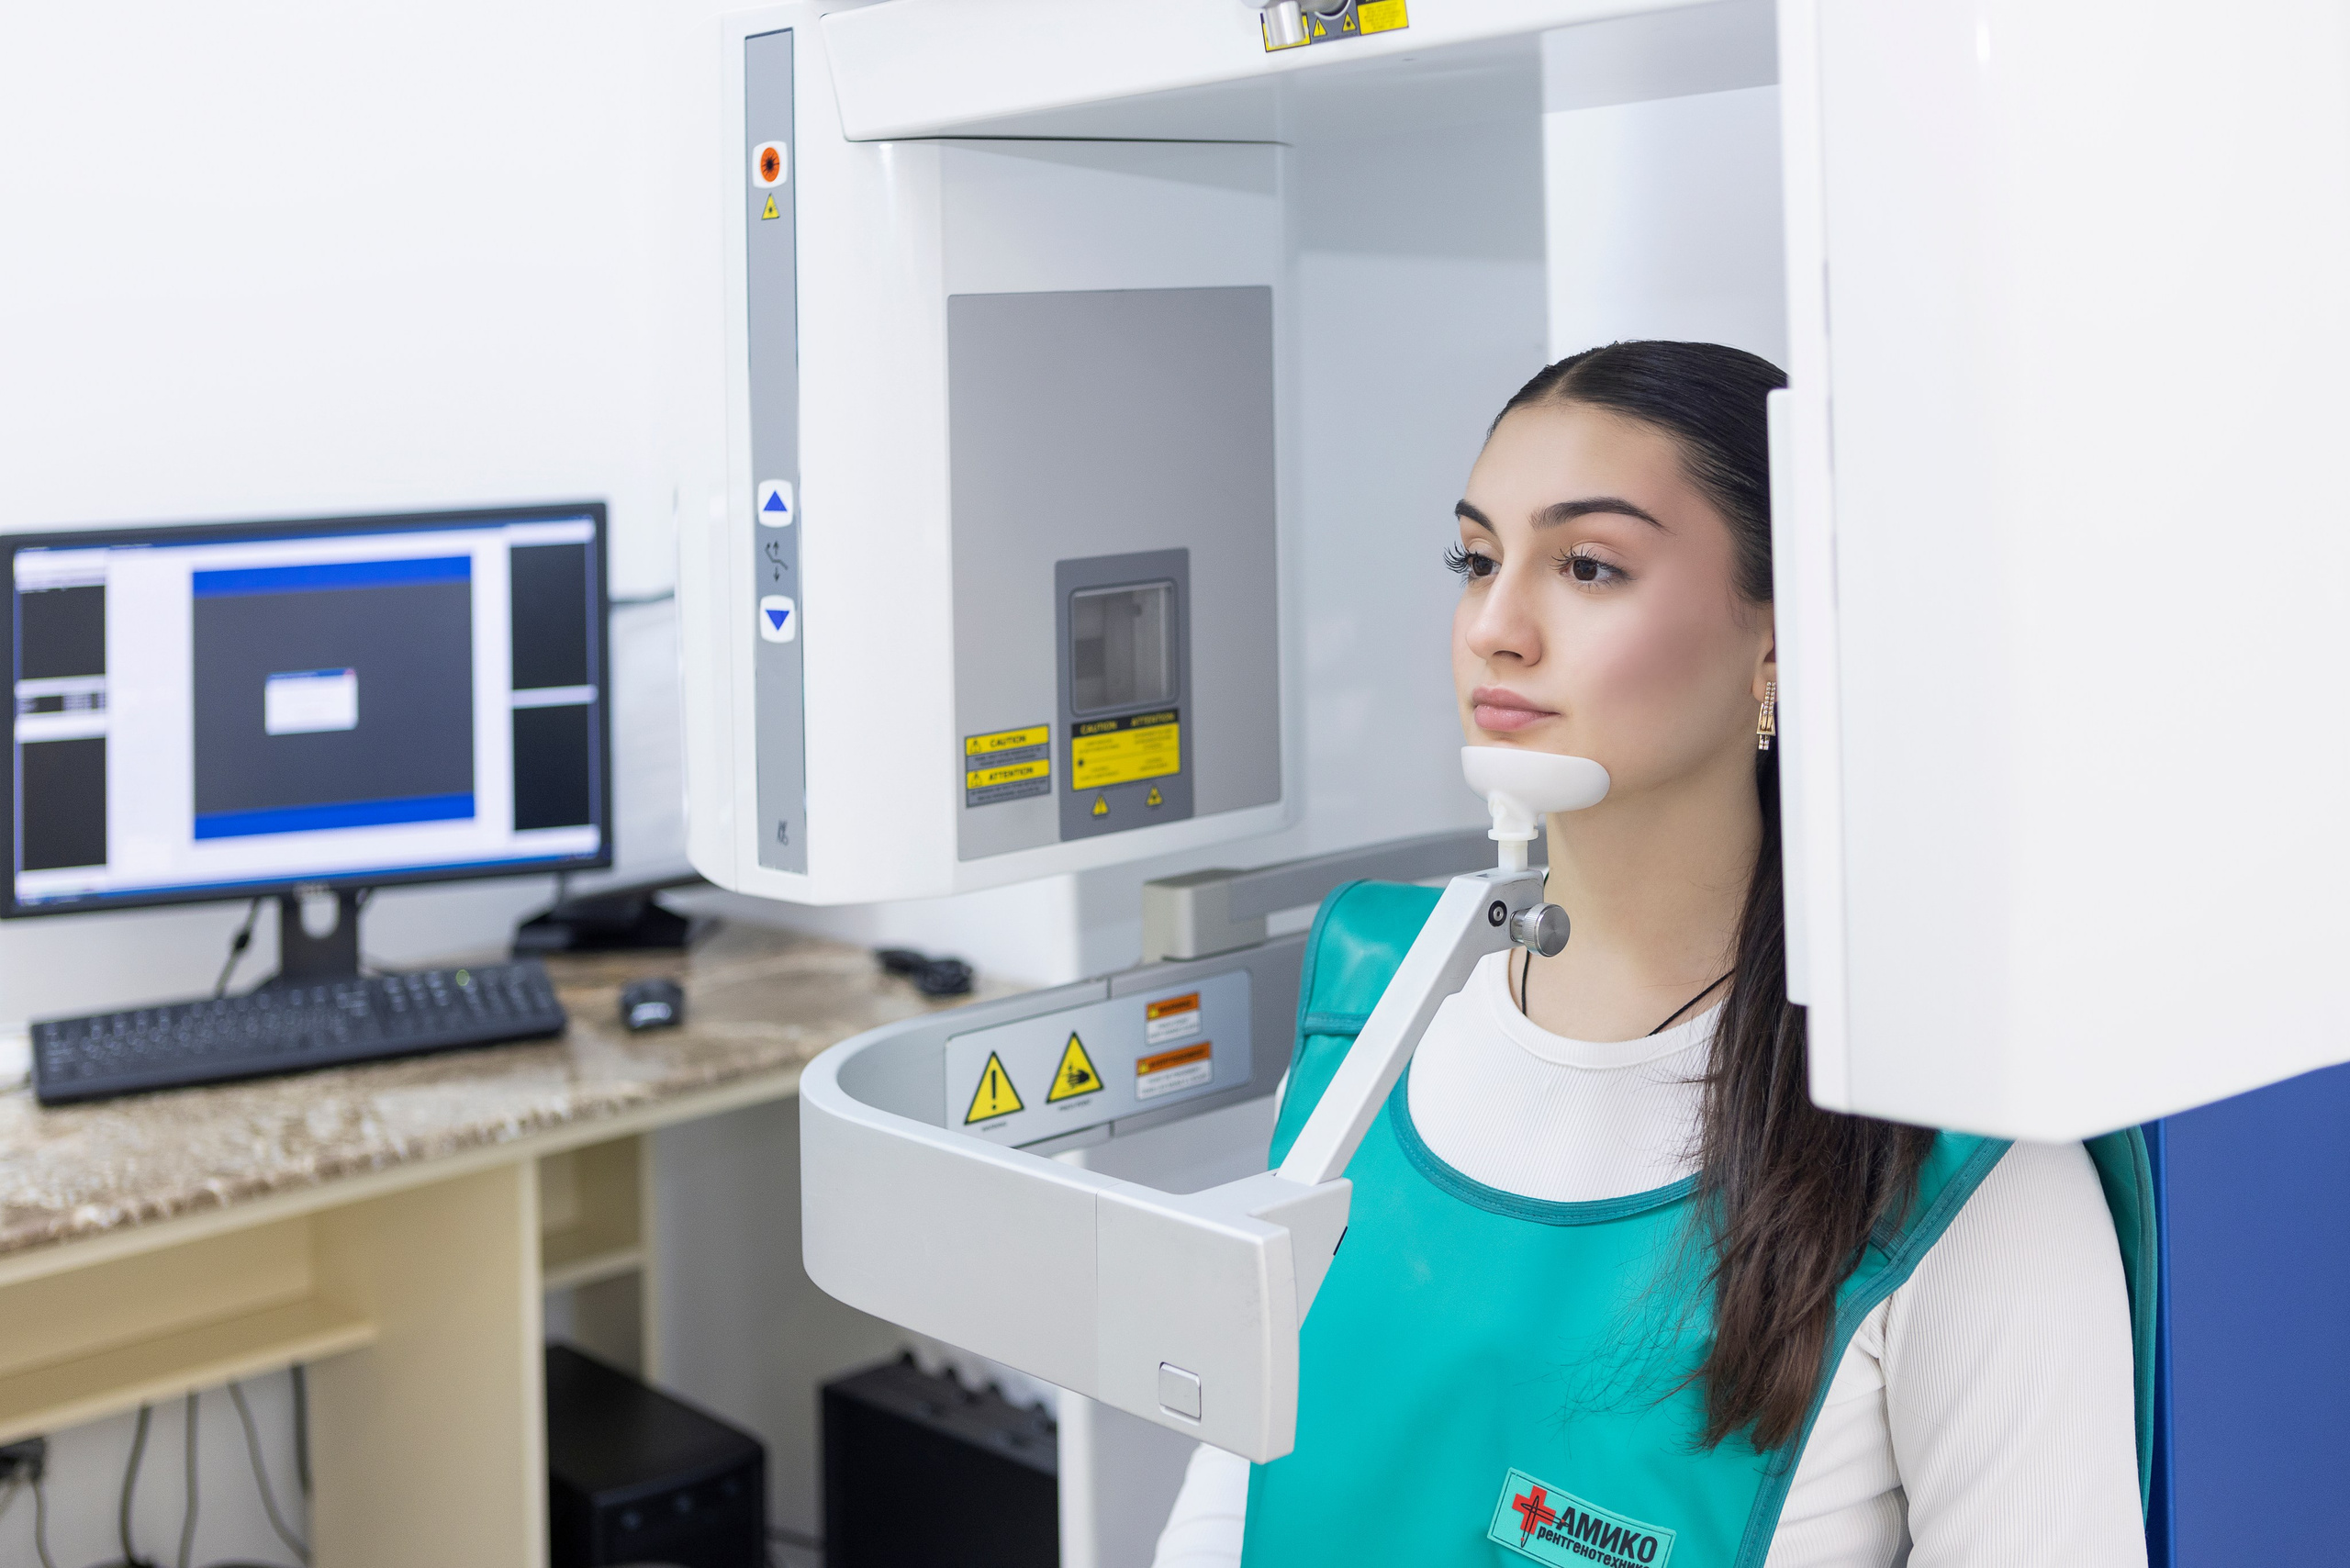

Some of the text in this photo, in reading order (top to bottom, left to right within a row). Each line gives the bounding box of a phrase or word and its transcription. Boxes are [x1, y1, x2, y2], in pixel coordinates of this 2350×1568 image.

[1080, 720, 1118, 735] CAUTION
[990, 735, 1026, 747] CAUTION
[989, 767, 1034, 781] ATTENTION
[1556, 1506, 1658, 1563] АМИКО
